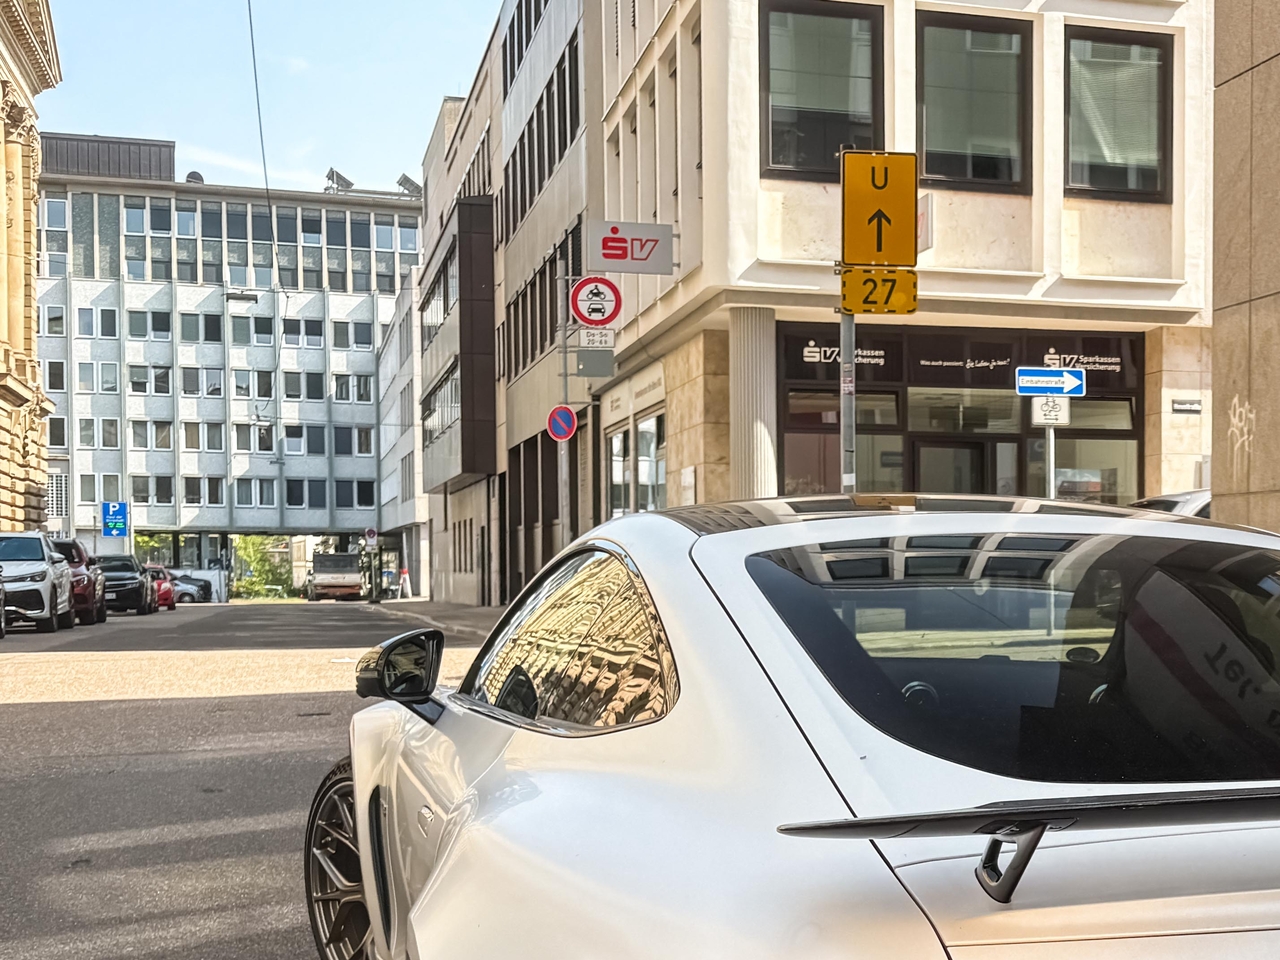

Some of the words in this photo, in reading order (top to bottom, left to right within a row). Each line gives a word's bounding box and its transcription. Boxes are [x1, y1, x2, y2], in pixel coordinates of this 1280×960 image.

[870, 166, 888, 190] U
[862, 278, 897, 305] 27
[1079, 355, 1121, 363] Sparkassen
[1074, 363, 1121, 373] Versicherung
[109, 503, 120, 515] P
